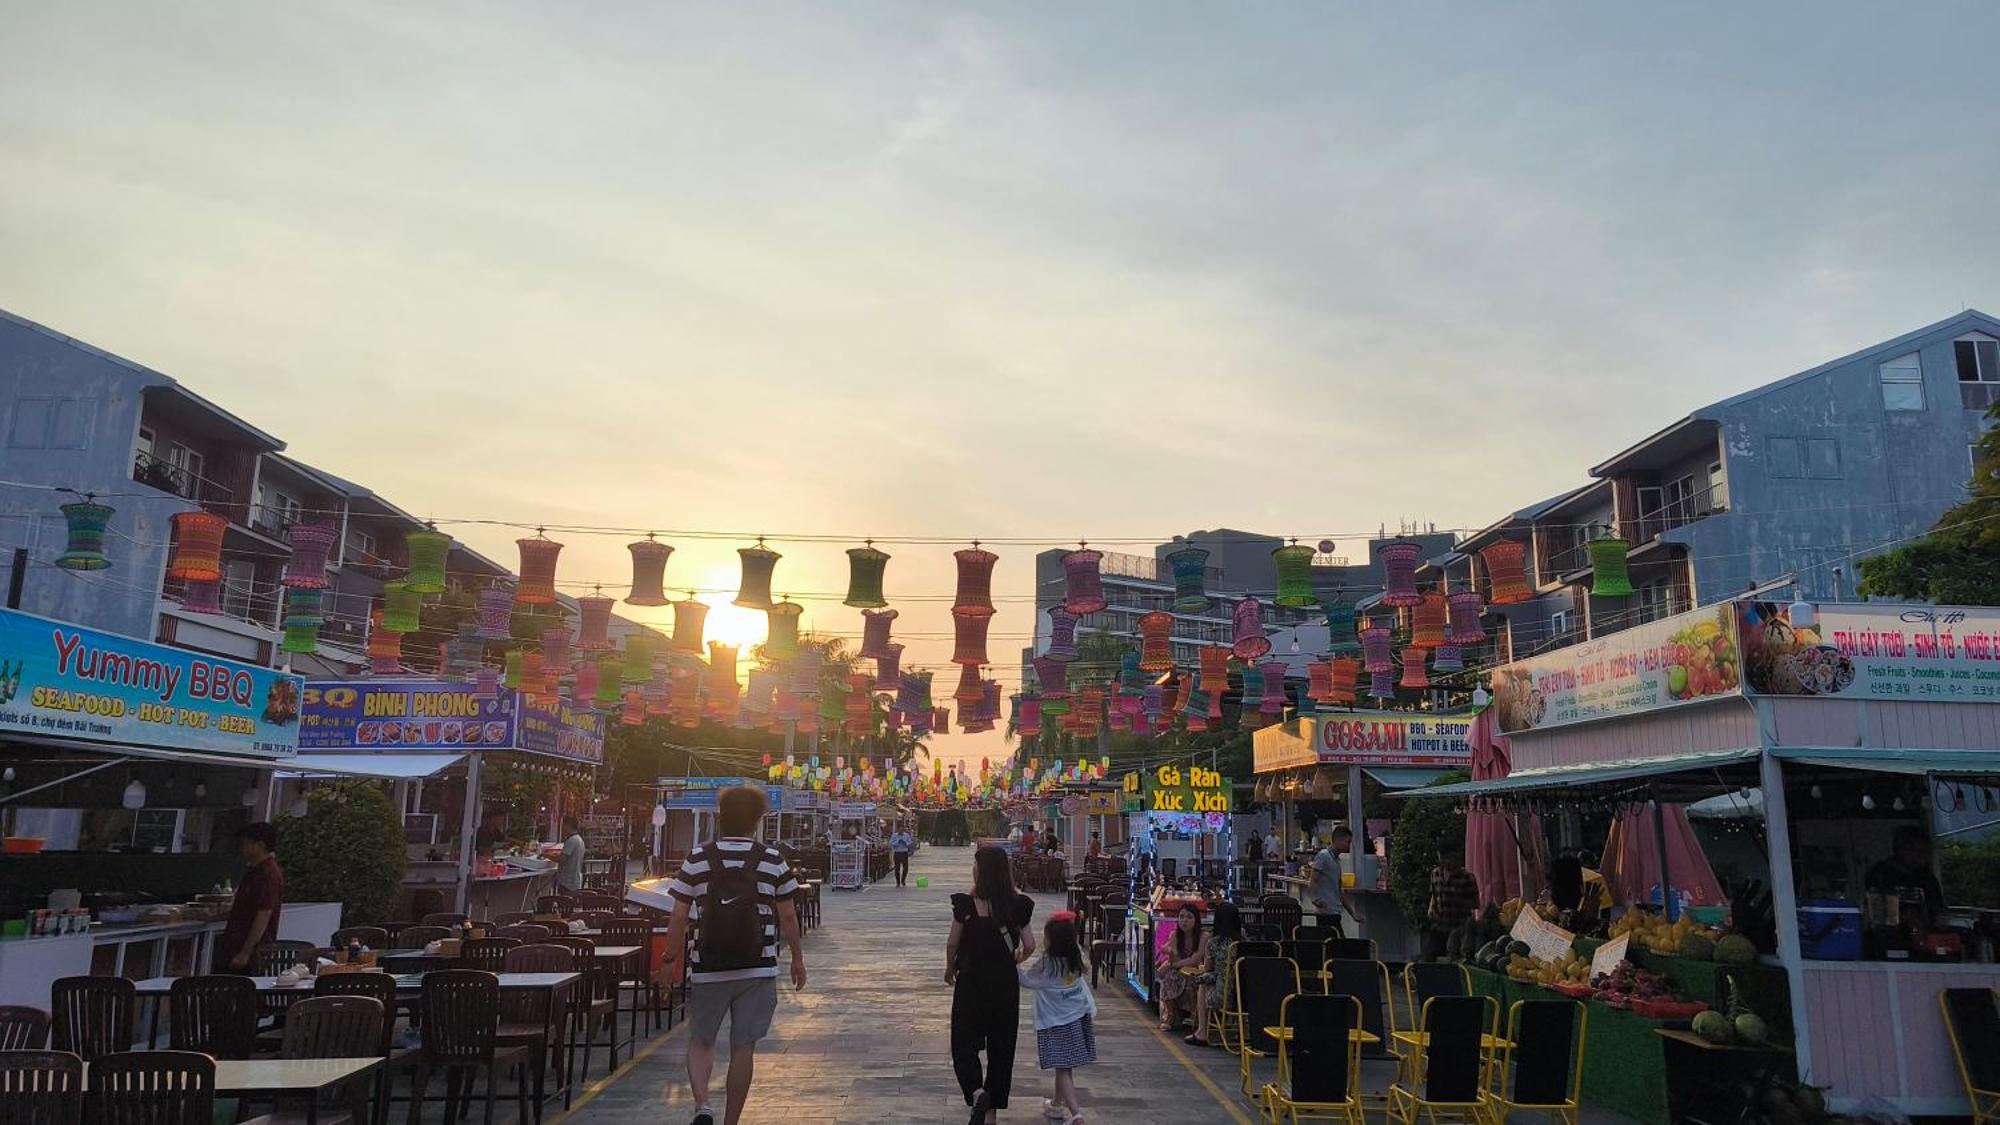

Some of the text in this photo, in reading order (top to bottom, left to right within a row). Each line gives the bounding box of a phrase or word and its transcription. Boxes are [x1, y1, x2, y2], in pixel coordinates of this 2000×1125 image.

[1914, 633, 1939, 659] SINH
[54, 629, 254, 707] Yummy BBQ
[32, 685, 257, 735] SEAFOOD HOT POT BEER
[413, 692, 480, 716] PHONG
[1323, 720, 1408, 751] GOSAMI
[1410, 722, 1426, 735] BBQ
[1411, 739, 1441, 752] HOTPOT
[1152, 790, 1184, 811] Xúc
